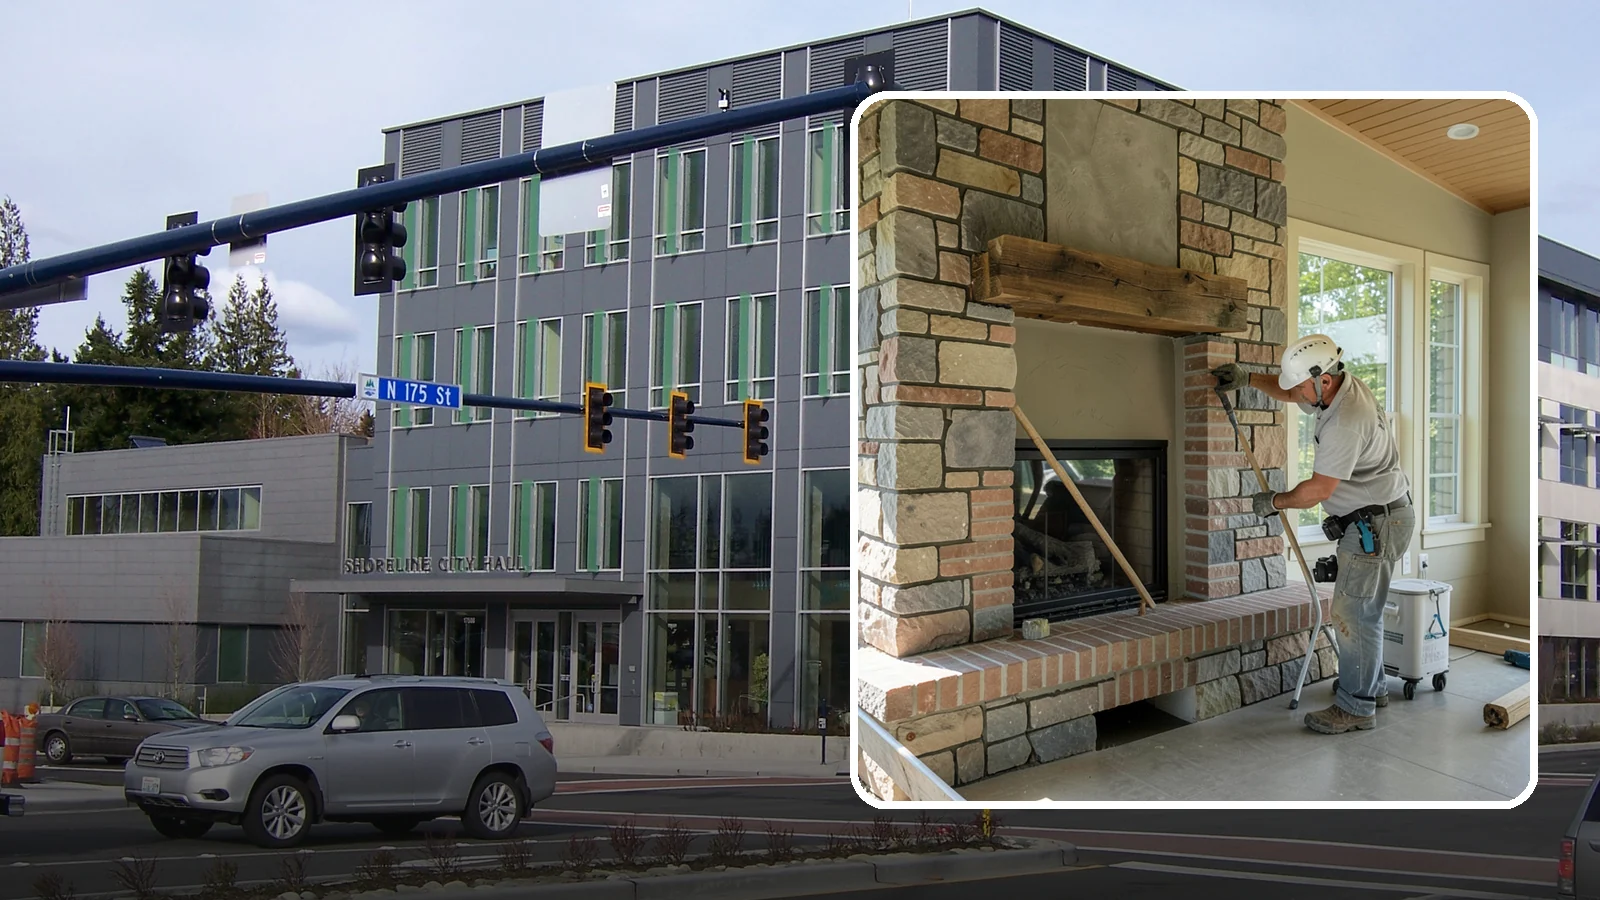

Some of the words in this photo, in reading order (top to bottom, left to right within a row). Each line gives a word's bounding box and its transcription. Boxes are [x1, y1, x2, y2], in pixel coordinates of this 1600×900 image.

[387, 380, 396, 399] N
[405, 382, 427, 403] 175
[436, 386, 451, 405] St
[343, 556, 432, 574] SHORELINE
[438, 555, 476, 572] CITY
[484, 555, 525, 571] HALL
